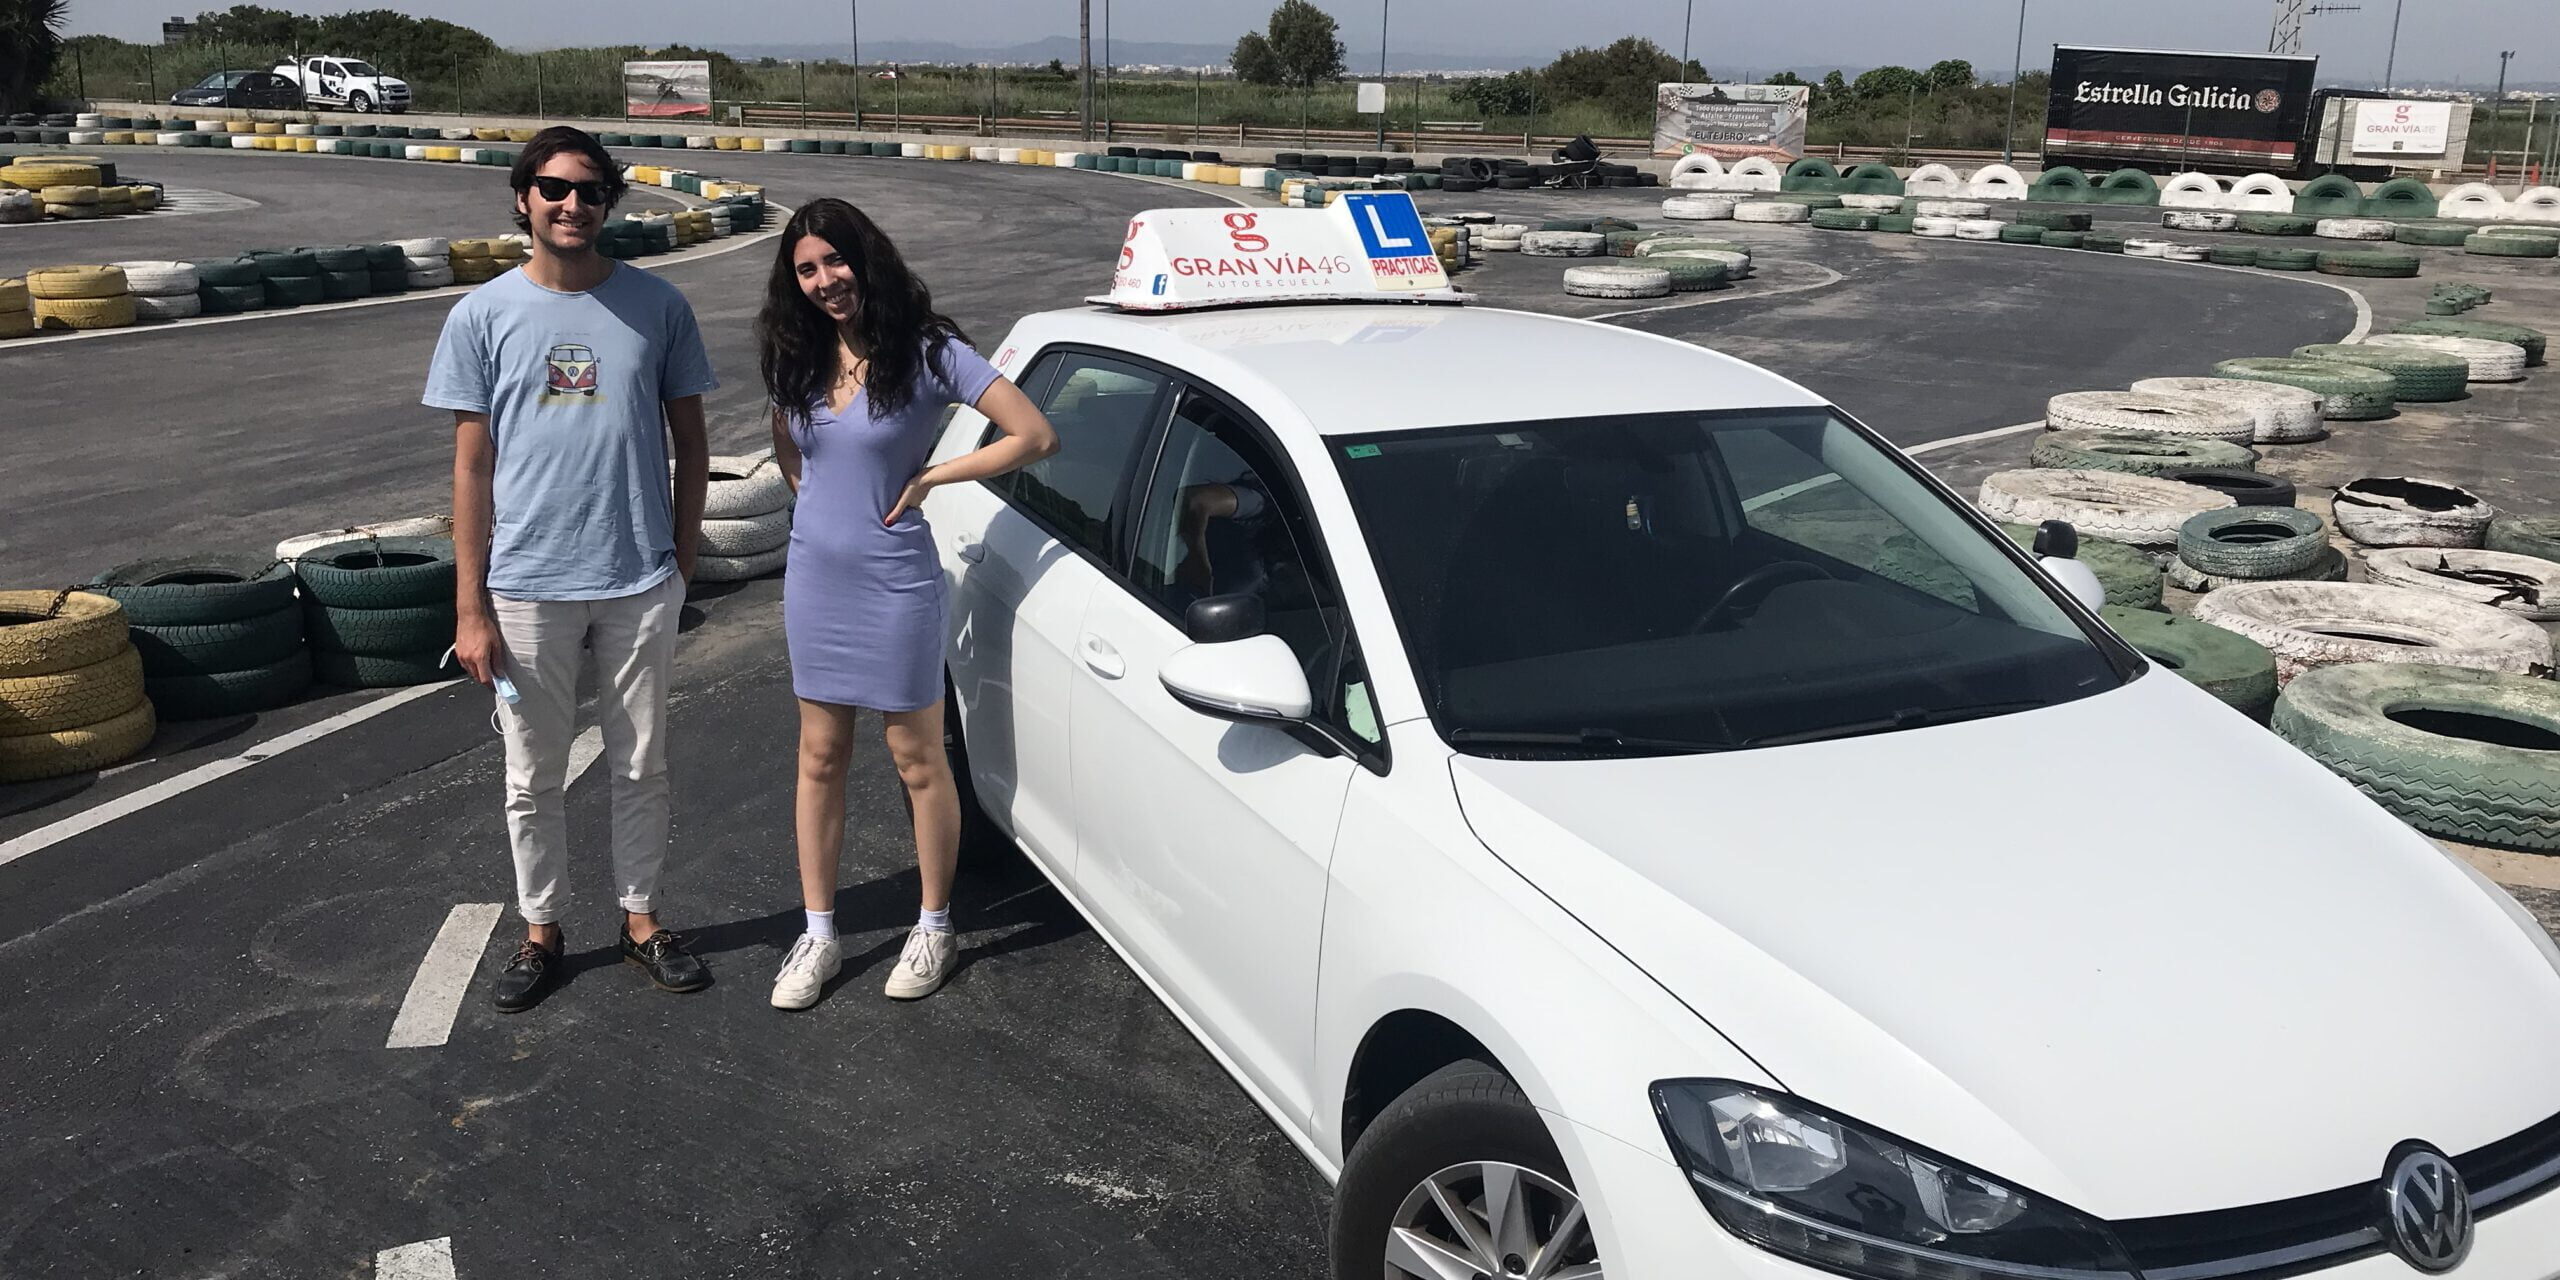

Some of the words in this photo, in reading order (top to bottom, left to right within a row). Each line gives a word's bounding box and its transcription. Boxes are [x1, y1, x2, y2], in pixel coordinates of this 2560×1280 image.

[2074, 81, 2163, 106] Estrella
[2168, 84, 2250, 110] Galicia
[2394, 105, 2412, 124] g
[2366, 125, 2399, 133] GRAN
[1224, 213, 1269, 252] g
[1364, 204, 1413, 249] L
[1174, 257, 1259, 276] GRAN
[1371, 256, 1439, 277] PRACTICAS
[1206, 278, 1332, 289] AUTOESCUELA
